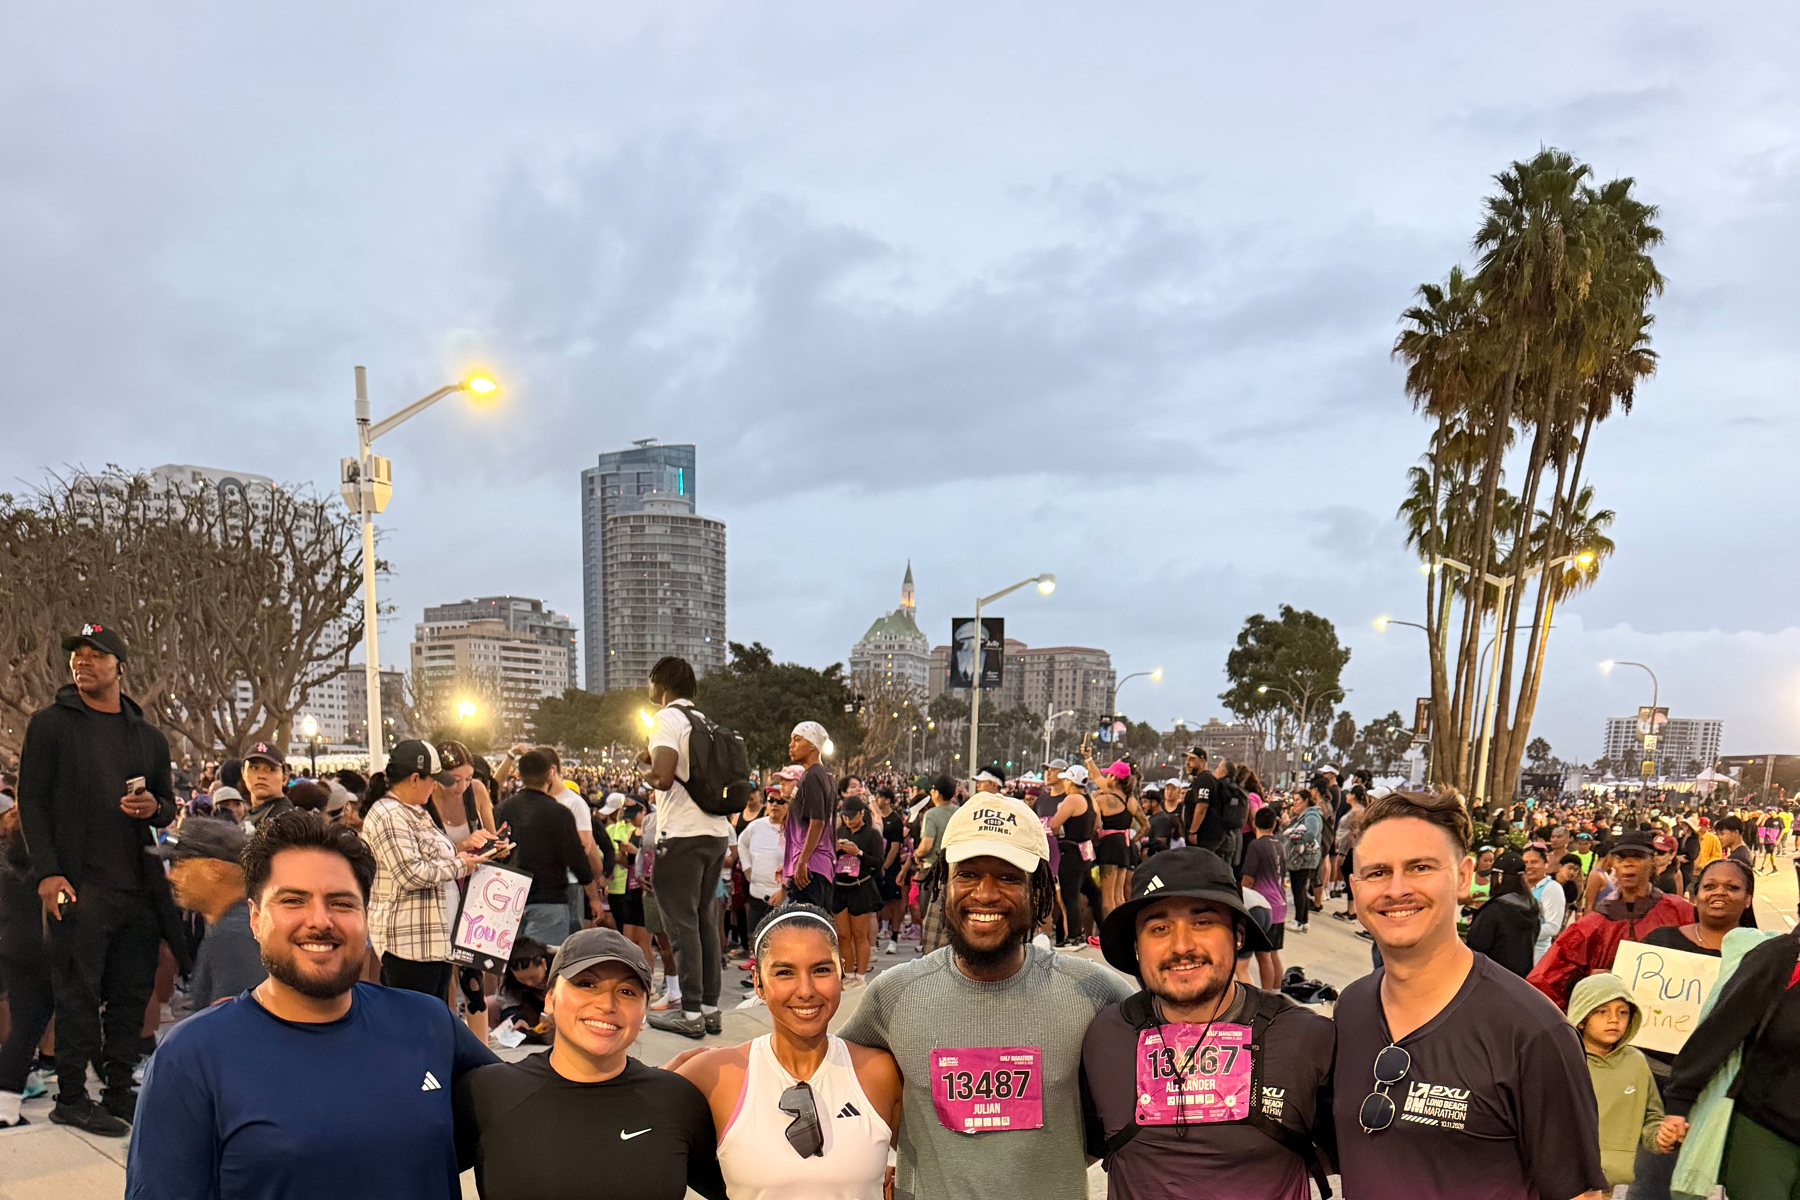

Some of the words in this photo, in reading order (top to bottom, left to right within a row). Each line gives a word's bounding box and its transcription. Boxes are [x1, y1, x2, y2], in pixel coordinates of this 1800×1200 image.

[972, 808, 1018, 827] UCLA
[1632, 951, 1701, 1005] Run
[1147, 1044, 1240, 1080] 13467
[941, 1069, 1032, 1101] 13487
[973, 1103, 1001, 1115] JULIAN
[1424, 1105, 1467, 1121] MARATHON
[1443, 1100, 1468, 1112] BEACH
